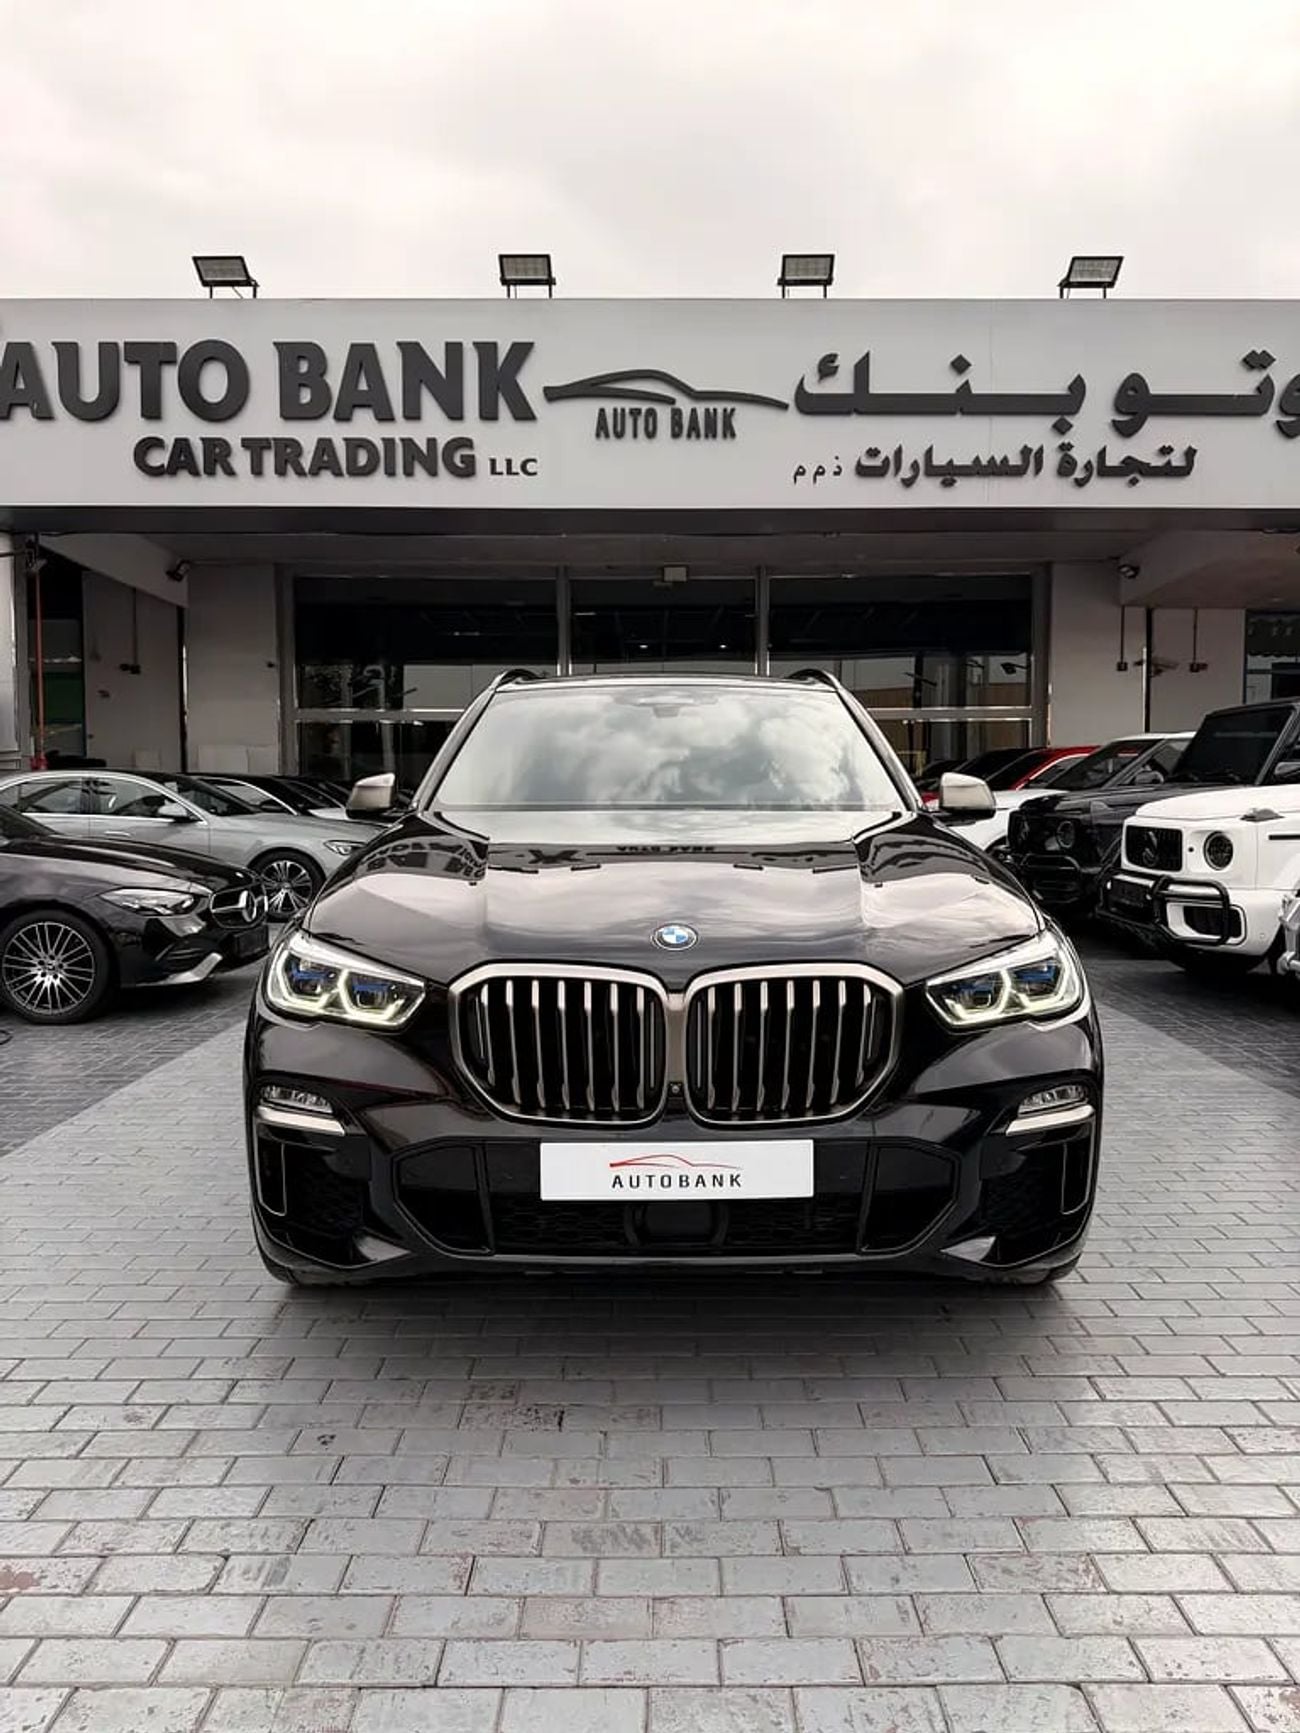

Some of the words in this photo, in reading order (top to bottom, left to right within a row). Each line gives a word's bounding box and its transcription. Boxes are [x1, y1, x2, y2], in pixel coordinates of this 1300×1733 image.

[0, 339, 250, 422] AUTO
[272, 341, 538, 422] BANK
[794, 350, 1087, 436] بنك
[595, 407, 658, 440] AUTO
[670, 407, 737, 440] BANK
[133, 436, 237, 477] CAR
[241, 436, 477, 478] TRADING
[488, 458, 538, 476] LLC
[855, 444, 1044, 488] السيارات
[1056, 441, 1198, 488] لتجارة
[611, 1173, 742, 1189] AUTOBANK
